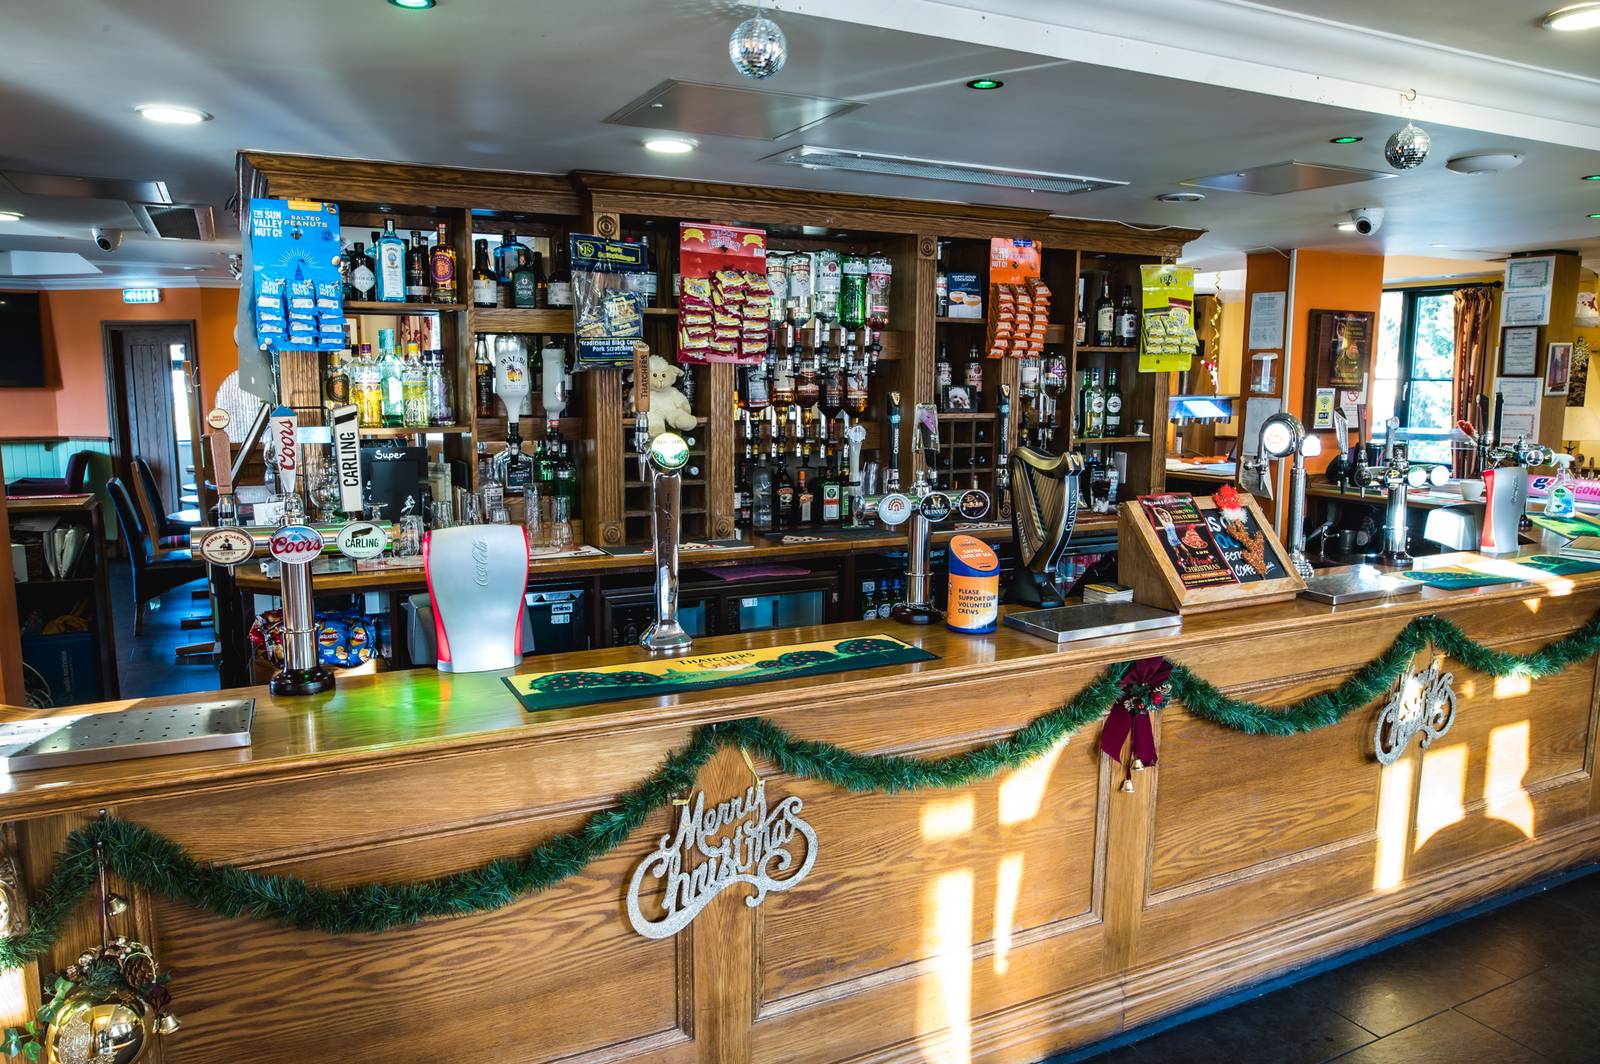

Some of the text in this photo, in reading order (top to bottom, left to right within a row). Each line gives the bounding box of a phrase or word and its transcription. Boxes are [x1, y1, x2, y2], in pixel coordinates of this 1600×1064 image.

[264, 210, 281, 220] SUN
[253, 218, 283, 228] VALLEY
[283, 219, 328, 228] PEANUTS
[254, 227, 272, 237] NUT
[640, 354, 648, 400] THATCHERS
[278, 418, 296, 471] Coors
[340, 432, 359, 487] CARLING
[374, 449, 406, 461] Super
[1064, 489, 1078, 532] GUINNESS
[269, 537, 324, 554] Coors
[345, 538, 379, 549] CARLING
[677, 652, 755, 665] THATCHERS
[658, 780, 768, 851] Merry
[626, 796, 819, 939] Christmas
